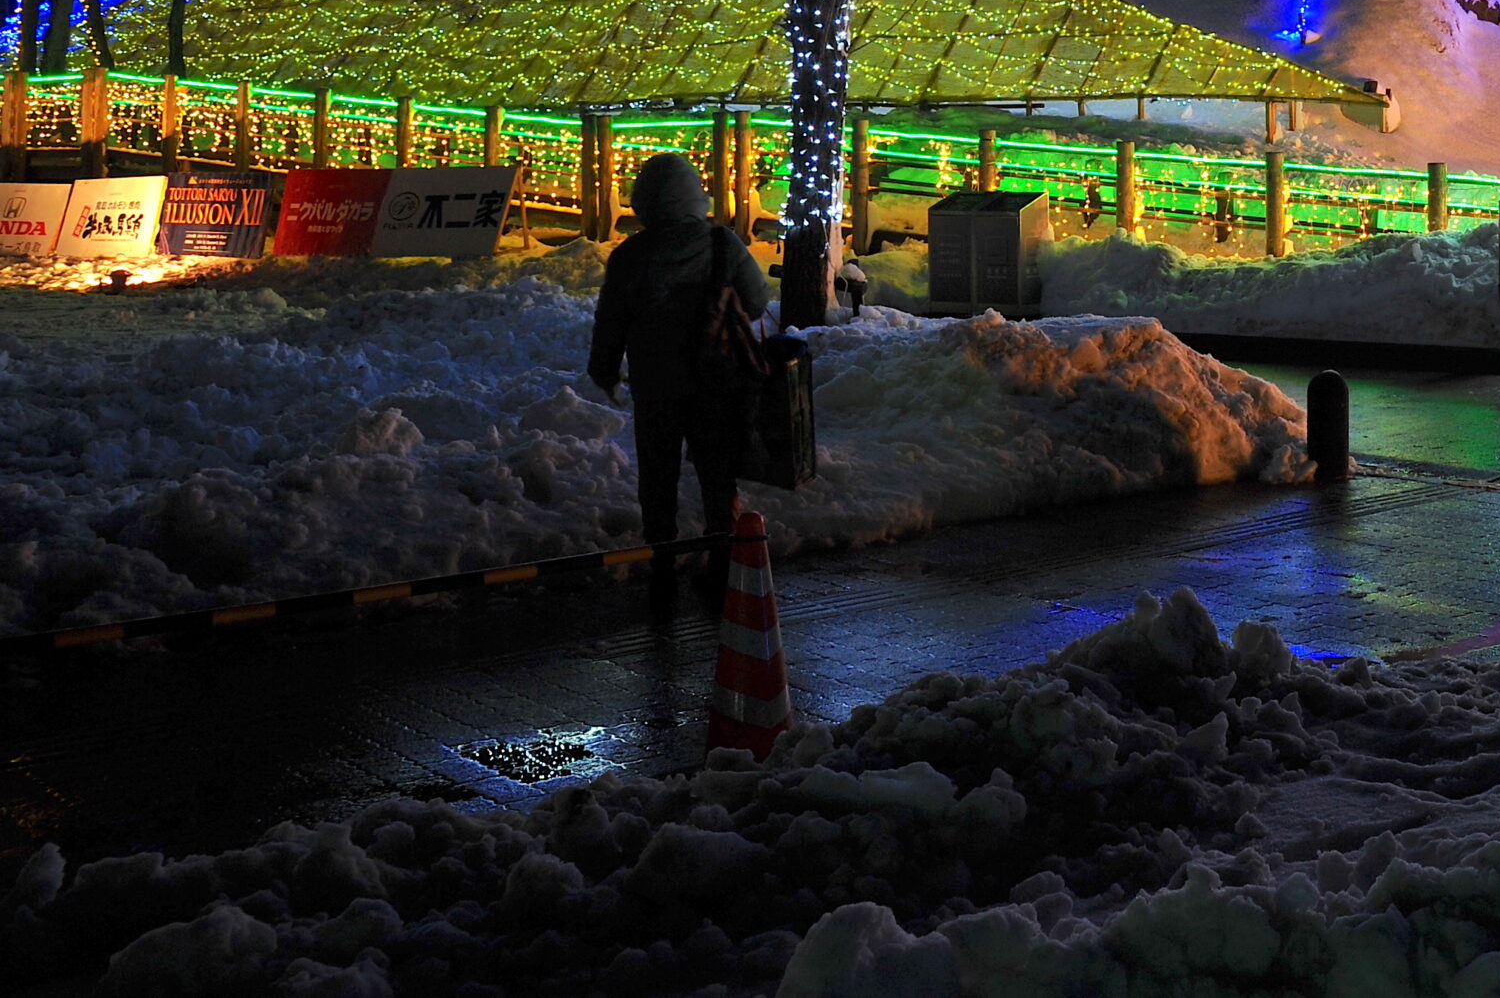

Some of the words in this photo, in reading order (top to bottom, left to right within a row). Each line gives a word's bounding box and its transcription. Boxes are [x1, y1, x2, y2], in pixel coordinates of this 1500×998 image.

[164, 202, 236, 225] ILLUSION
[168, 187, 208, 201] TOTTORI
[208, 188, 238, 202] SAKYU
[234, 188, 266, 226] XII
[286, 198, 375, 223] ニクバルダカラ
[417, 189, 506, 229] 不二家
